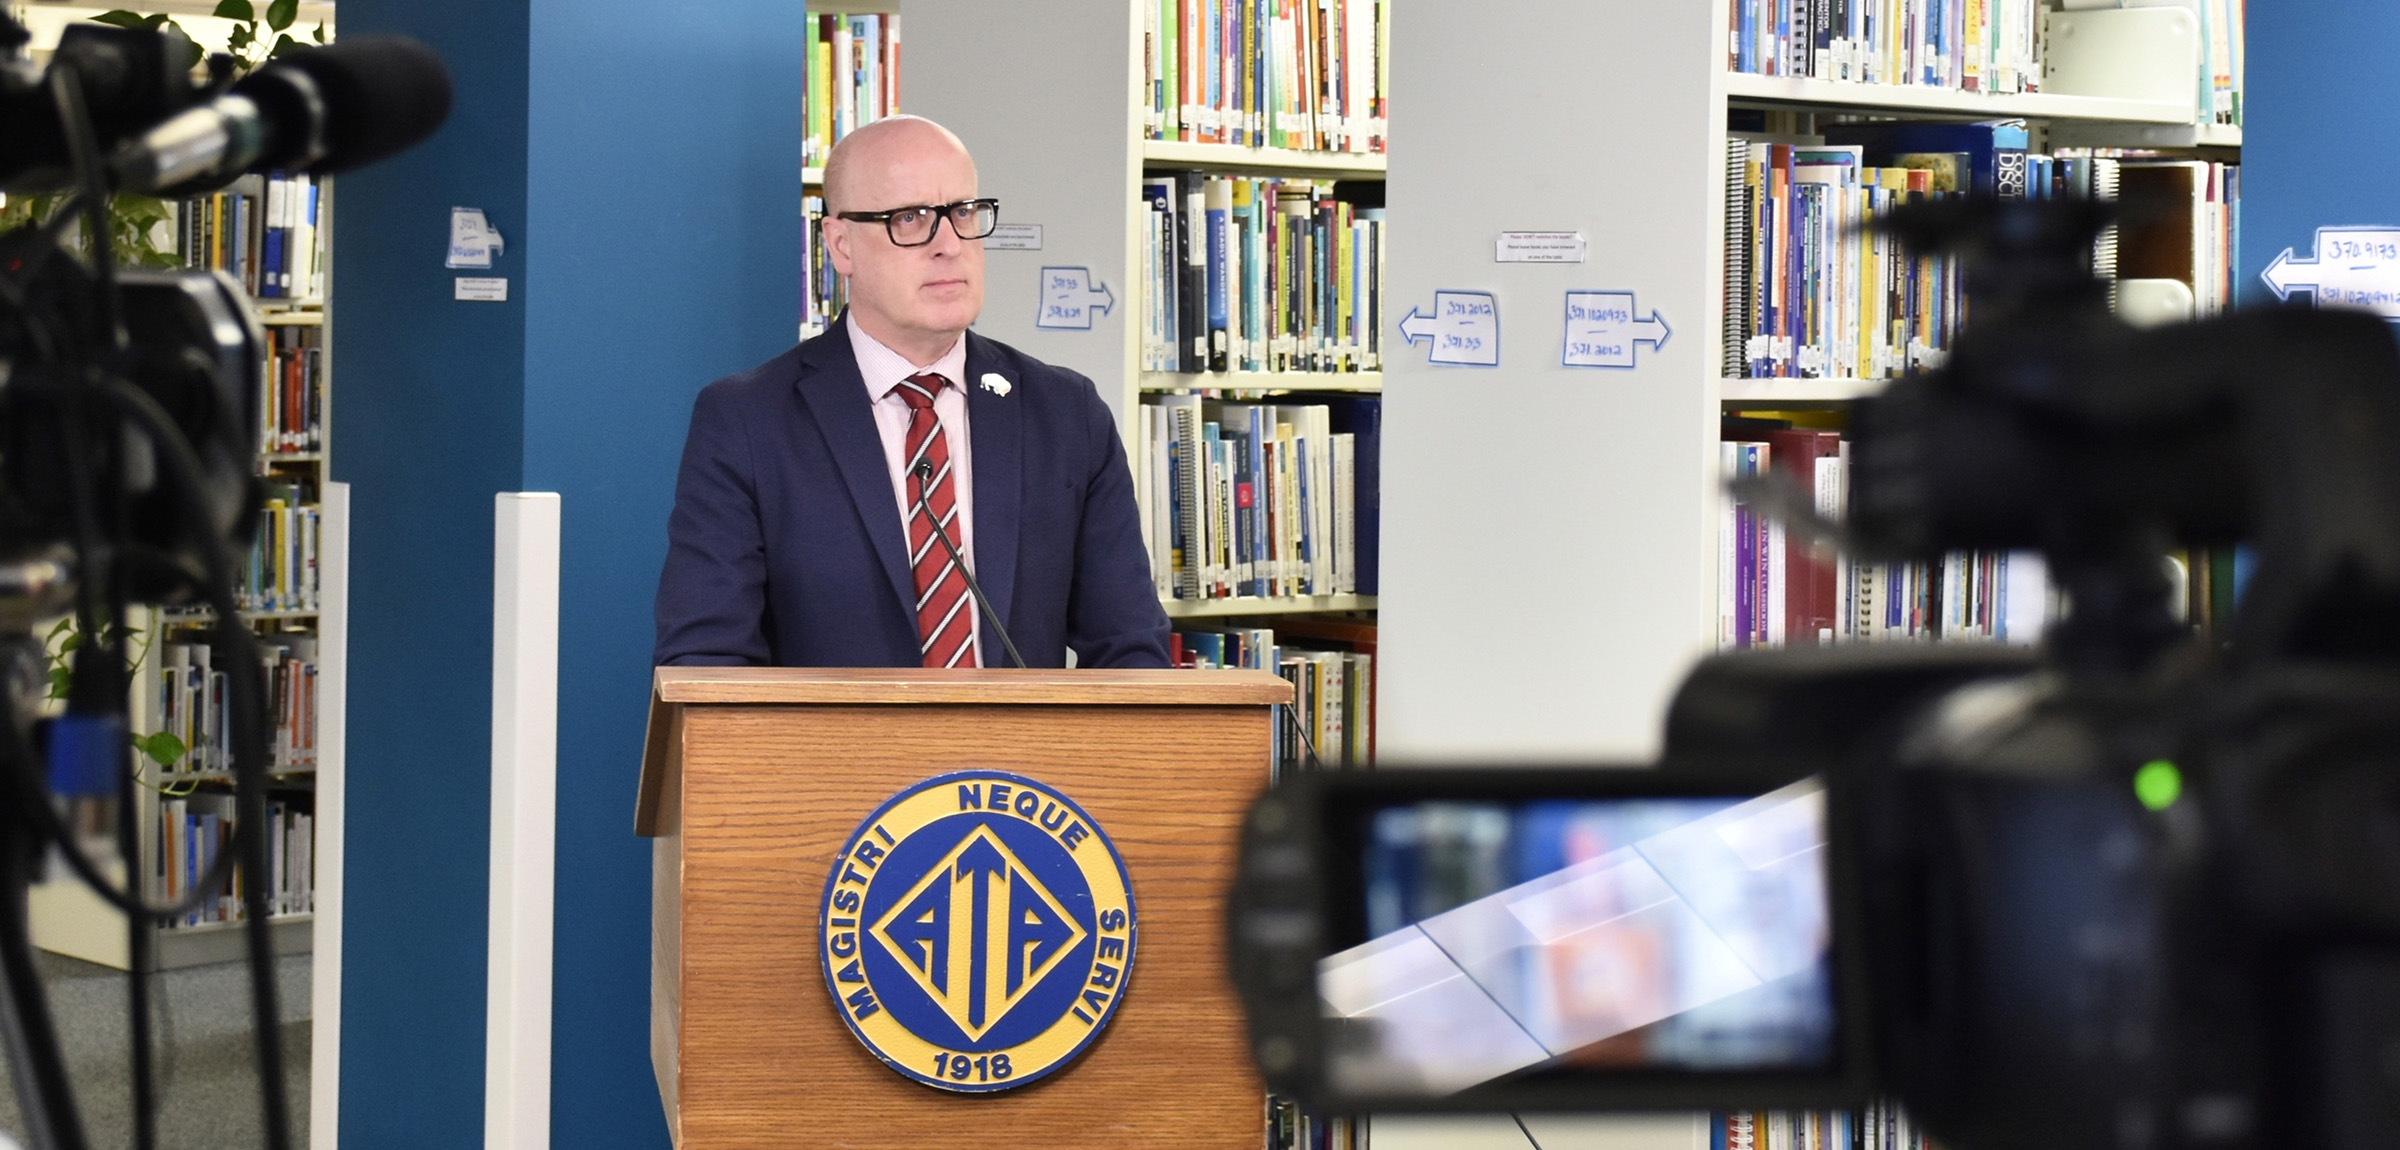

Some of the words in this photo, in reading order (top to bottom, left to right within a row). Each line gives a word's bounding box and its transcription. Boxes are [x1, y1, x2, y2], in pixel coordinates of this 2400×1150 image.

[1998, 153, 2013, 199] DISCI
[2014, 153, 2024, 199] COOPE
[958, 784, 1090, 851] NEQUE
[830, 824, 896, 1022] MAGISTRI
[883, 833, 1074, 1029] ATA
[1071, 909, 1126, 1025] SERVI
[934, 1052, 1013, 1081] 1918
